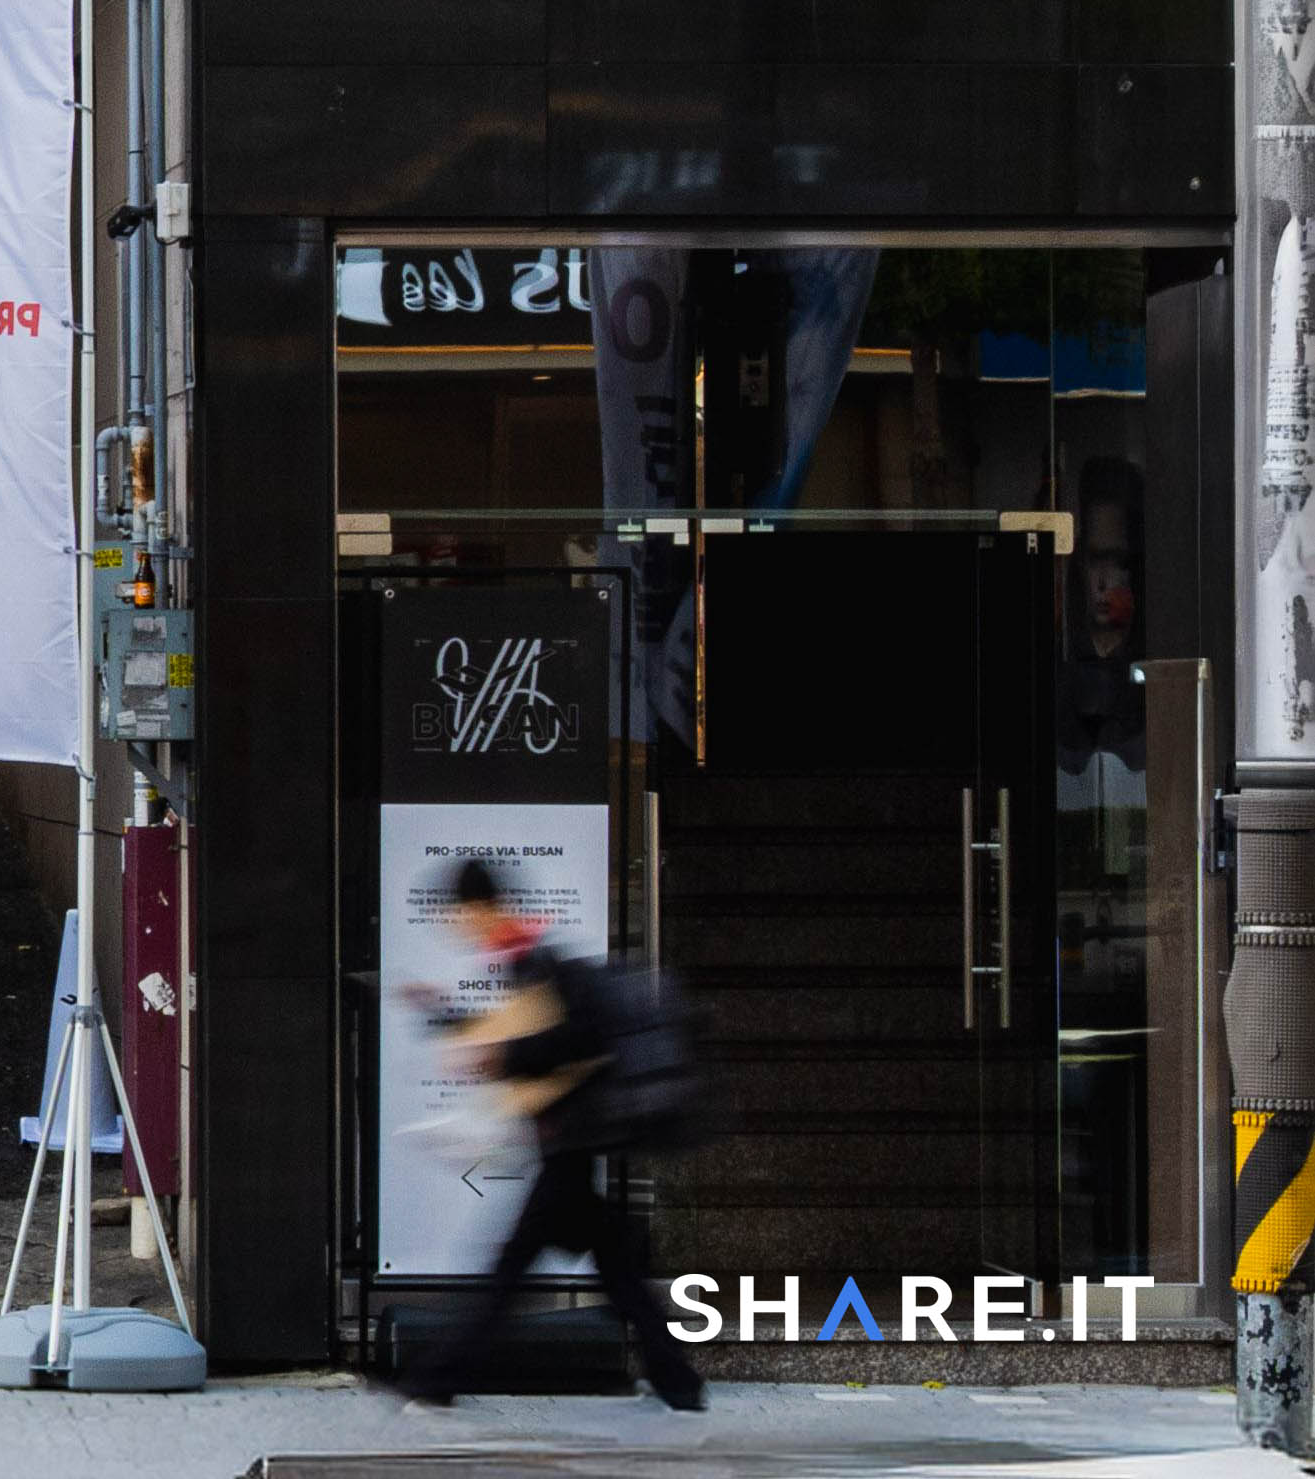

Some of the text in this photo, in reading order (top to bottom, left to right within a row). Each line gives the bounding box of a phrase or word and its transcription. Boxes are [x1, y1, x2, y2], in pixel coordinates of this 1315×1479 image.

[425, 846, 564, 857] PRO-SPECS VIA: BUSAN
[487, 963, 502, 974] 01
[458, 980, 492, 991] SHOE
